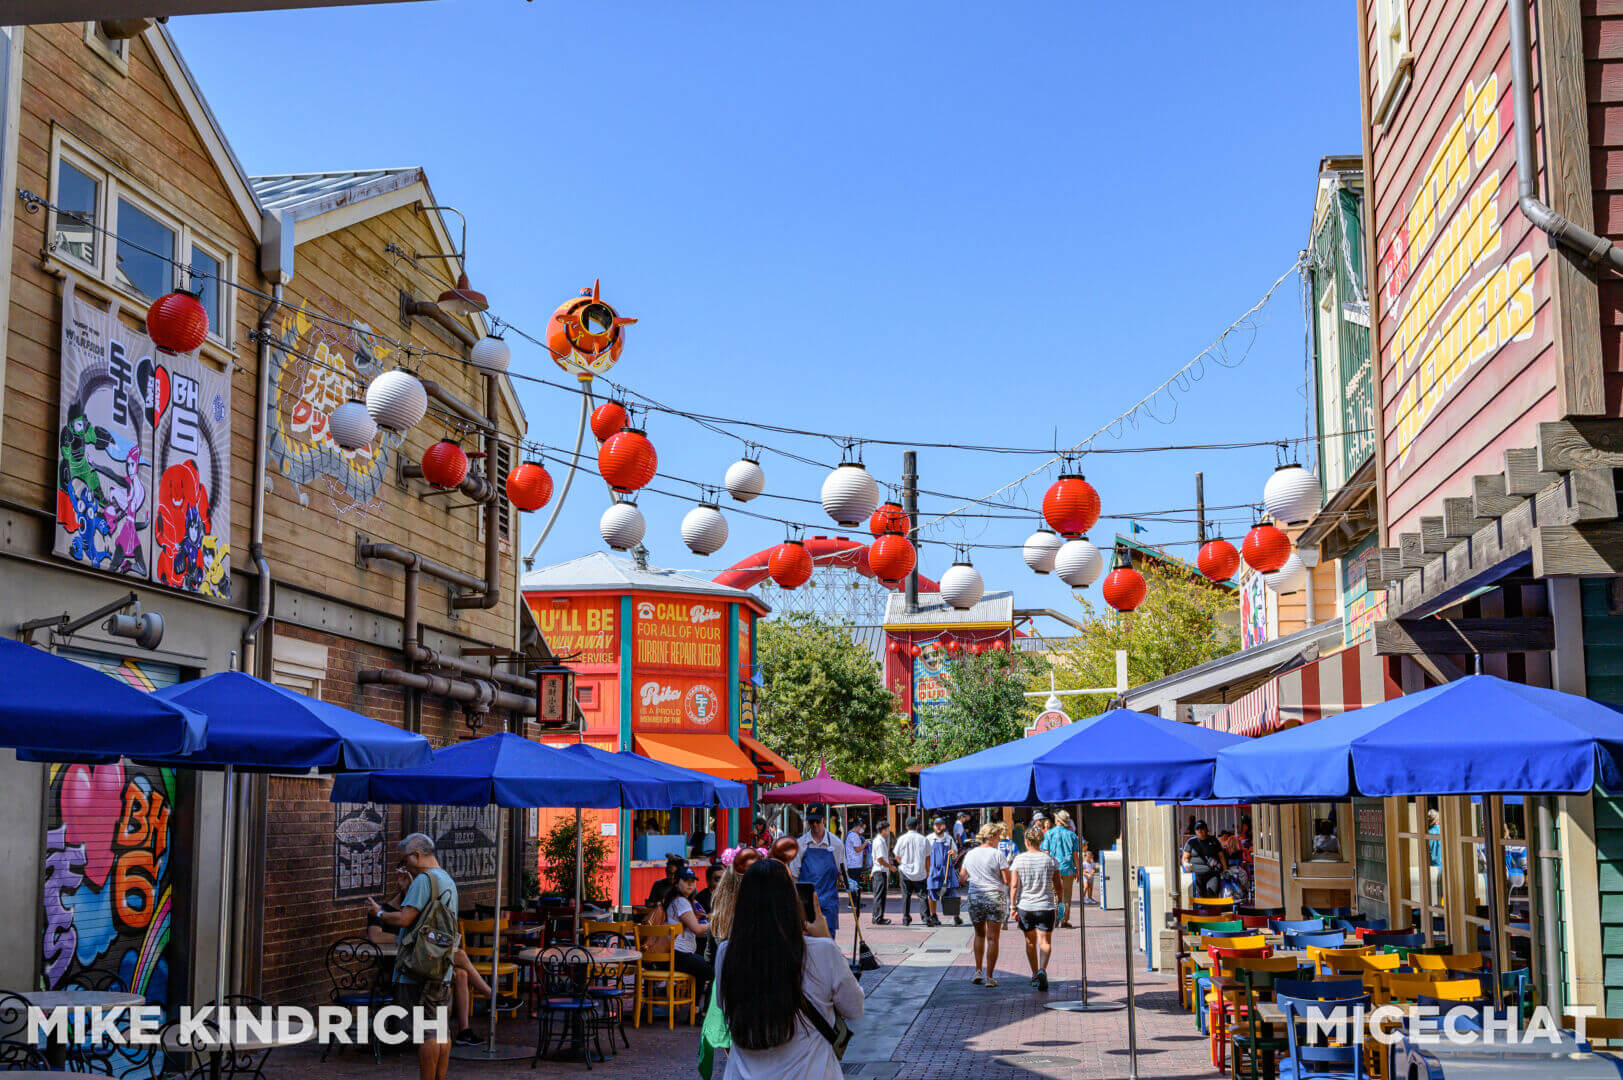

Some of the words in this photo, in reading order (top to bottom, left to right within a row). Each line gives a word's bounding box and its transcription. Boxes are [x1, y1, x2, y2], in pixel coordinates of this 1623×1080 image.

[1408, 72, 1499, 274] RITA'S
[1391, 169, 1502, 390] TURBINE
[1396, 252, 1535, 470] BLENDERS
[172, 372, 200, 413] BH
[170, 405, 199, 456] 6
[587, 608, 614, 631] BE
[637, 623, 658, 636] FOR
[660, 624, 677, 638] ALL
[679, 625, 692, 639] OF
[694, 626, 720, 640] YOUR
[656, 603, 689, 621] CALL
[544, 635, 573, 649] OWN
[574, 635, 614, 649] AWAY
[638, 640, 669, 664] TURBINE
[670, 641, 697, 665] REPAIR
[698, 643, 721, 667] NEEDS
[656, 707, 681, 716] PROUD
[117, 780, 171, 858] BH
[115, 850, 163, 929] 6
